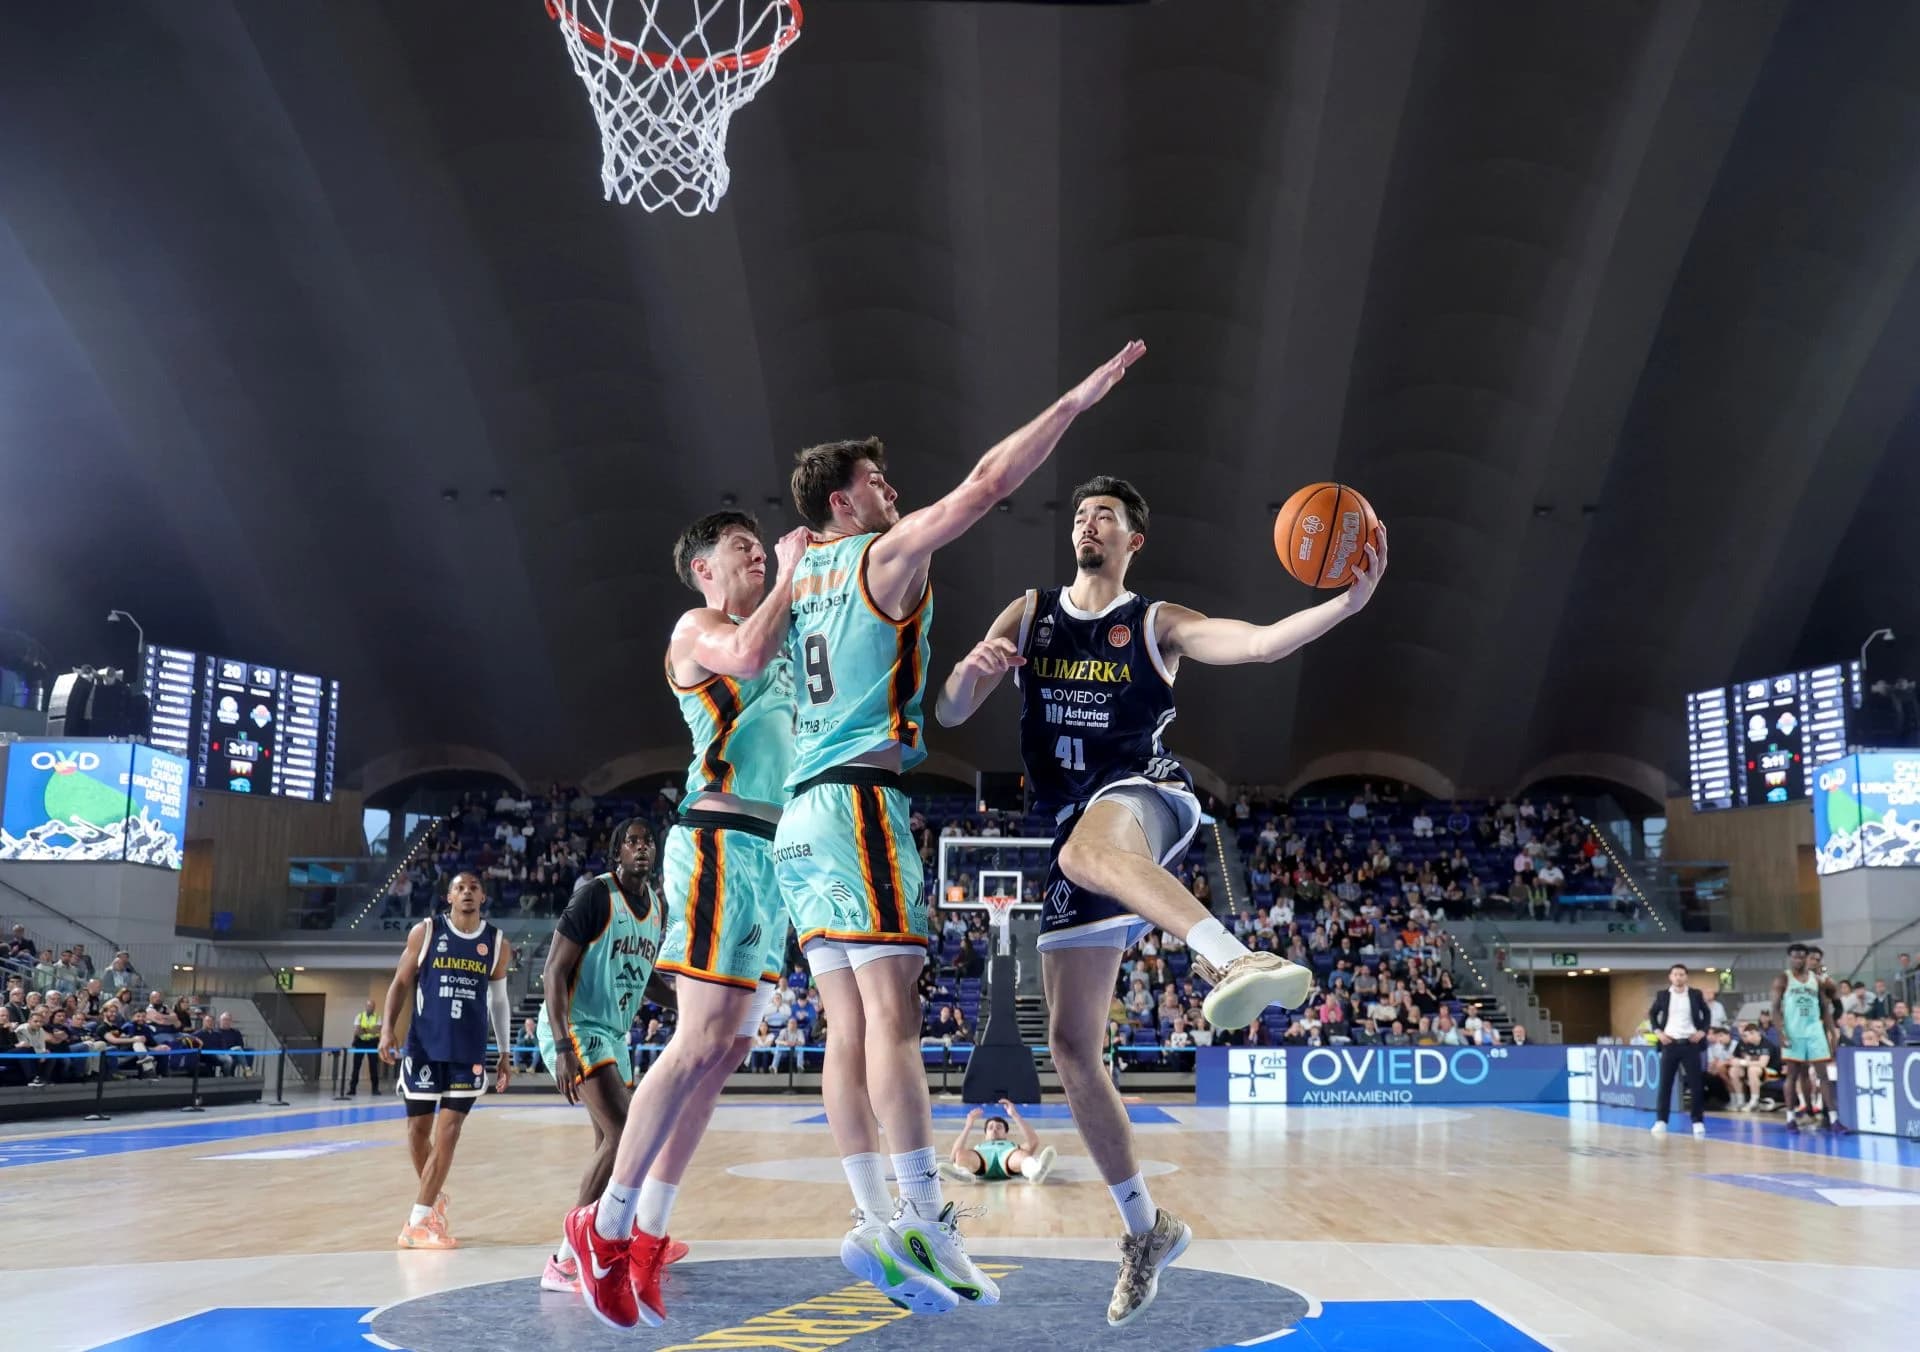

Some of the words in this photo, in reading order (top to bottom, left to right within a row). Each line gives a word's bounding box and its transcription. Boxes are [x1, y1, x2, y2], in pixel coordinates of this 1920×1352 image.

[253, 669, 271, 685] 13
[804, 631, 836, 707] 9
[1032, 656, 1132, 682] ALIMERKA
[1064, 705, 1110, 721] Asturias
[228, 742, 254, 757] 3:11
[1055, 735, 1086, 771] 41
[31, 751, 100, 772] OVD
[432, 956, 488, 975] ALIMERKA
[450, 999, 463, 1020] 5
[1302, 1090, 1413, 1103] AYUNTAMIENTO
